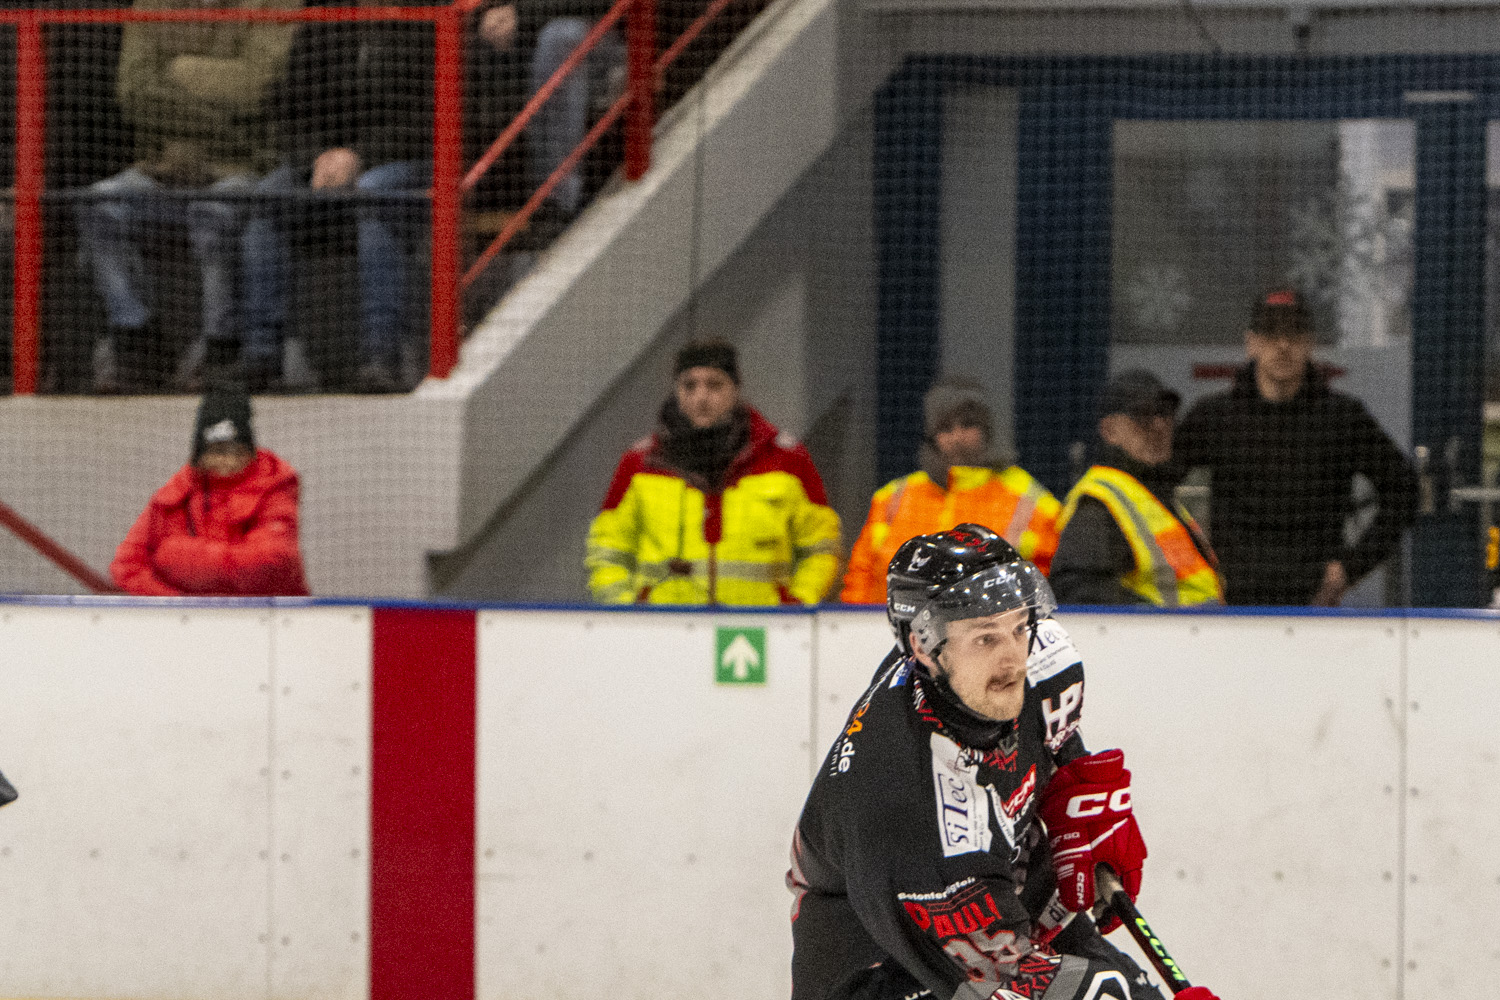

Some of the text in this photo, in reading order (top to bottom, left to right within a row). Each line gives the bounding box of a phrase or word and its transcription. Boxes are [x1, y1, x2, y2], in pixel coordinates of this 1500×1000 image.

[983, 573, 1017, 588] CCM
[893, 603, 916, 613] CCM
[1042, 681, 1083, 742] HP
[944, 776, 969, 845] SiTec
[1077, 872, 1085, 906] CCM
[903, 893, 1002, 939] PAULI
[1135, 918, 1187, 980] CCM
